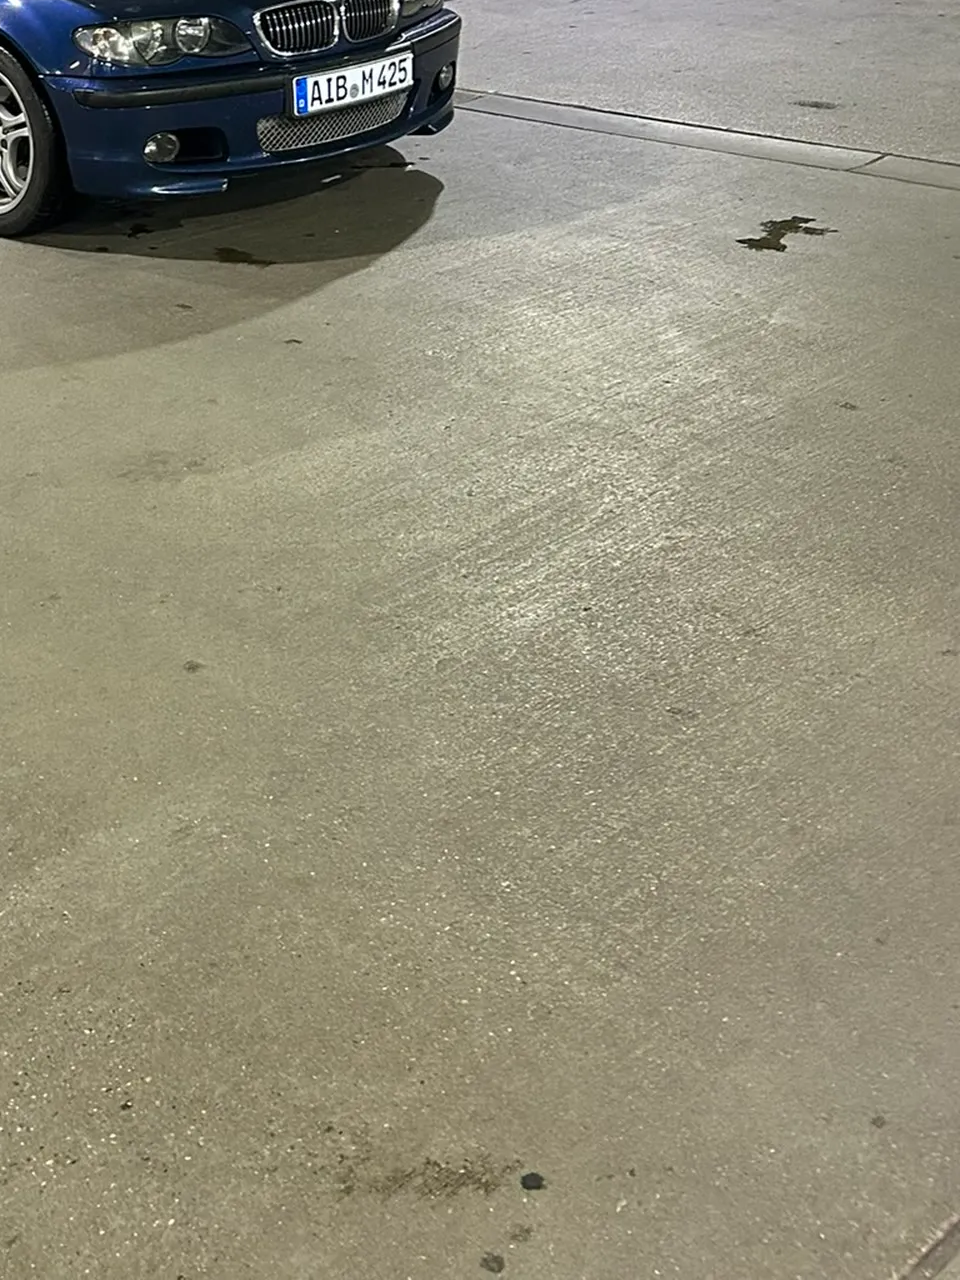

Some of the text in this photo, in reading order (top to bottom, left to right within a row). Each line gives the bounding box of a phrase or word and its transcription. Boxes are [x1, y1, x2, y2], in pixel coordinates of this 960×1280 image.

[311, 58, 408, 107] AIB M 425
